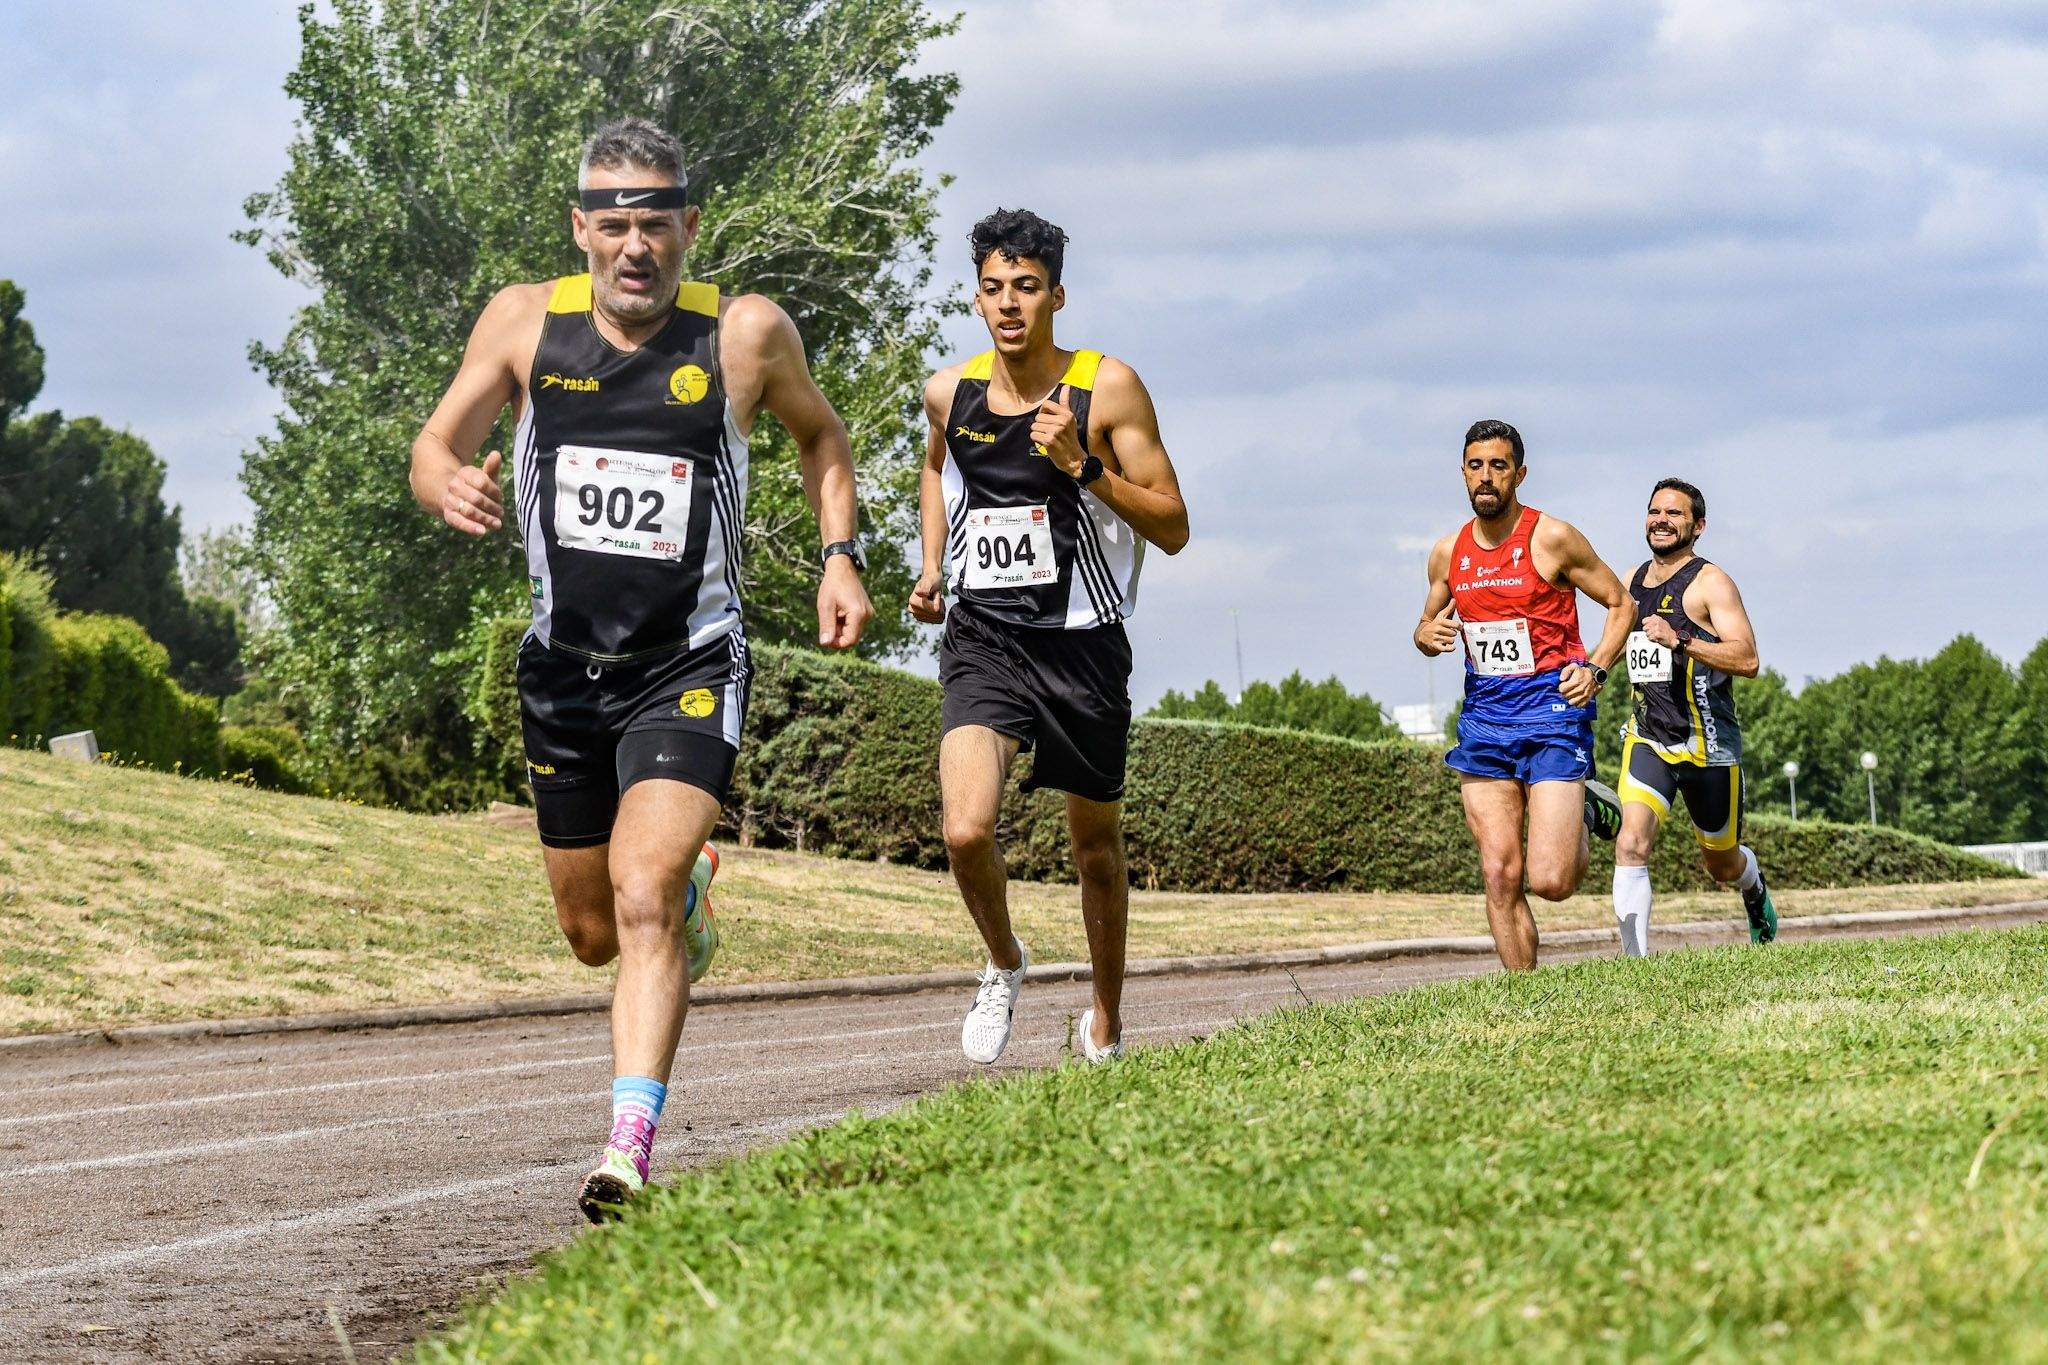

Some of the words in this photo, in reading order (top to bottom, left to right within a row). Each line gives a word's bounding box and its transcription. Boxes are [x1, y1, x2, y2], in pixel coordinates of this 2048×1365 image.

[563, 376, 600, 392] rasán
[578, 483, 665, 534] 902
[652, 541, 678, 553] 2023
[977, 533, 1036, 570] 904
[1031, 570, 1052, 579] 2023
[1456, 582, 1470, 592] A.D.
[1471, 577, 1523, 589] MARATHON
[1476, 639, 1520, 662] 743
[1630, 648, 1661, 670] 864
